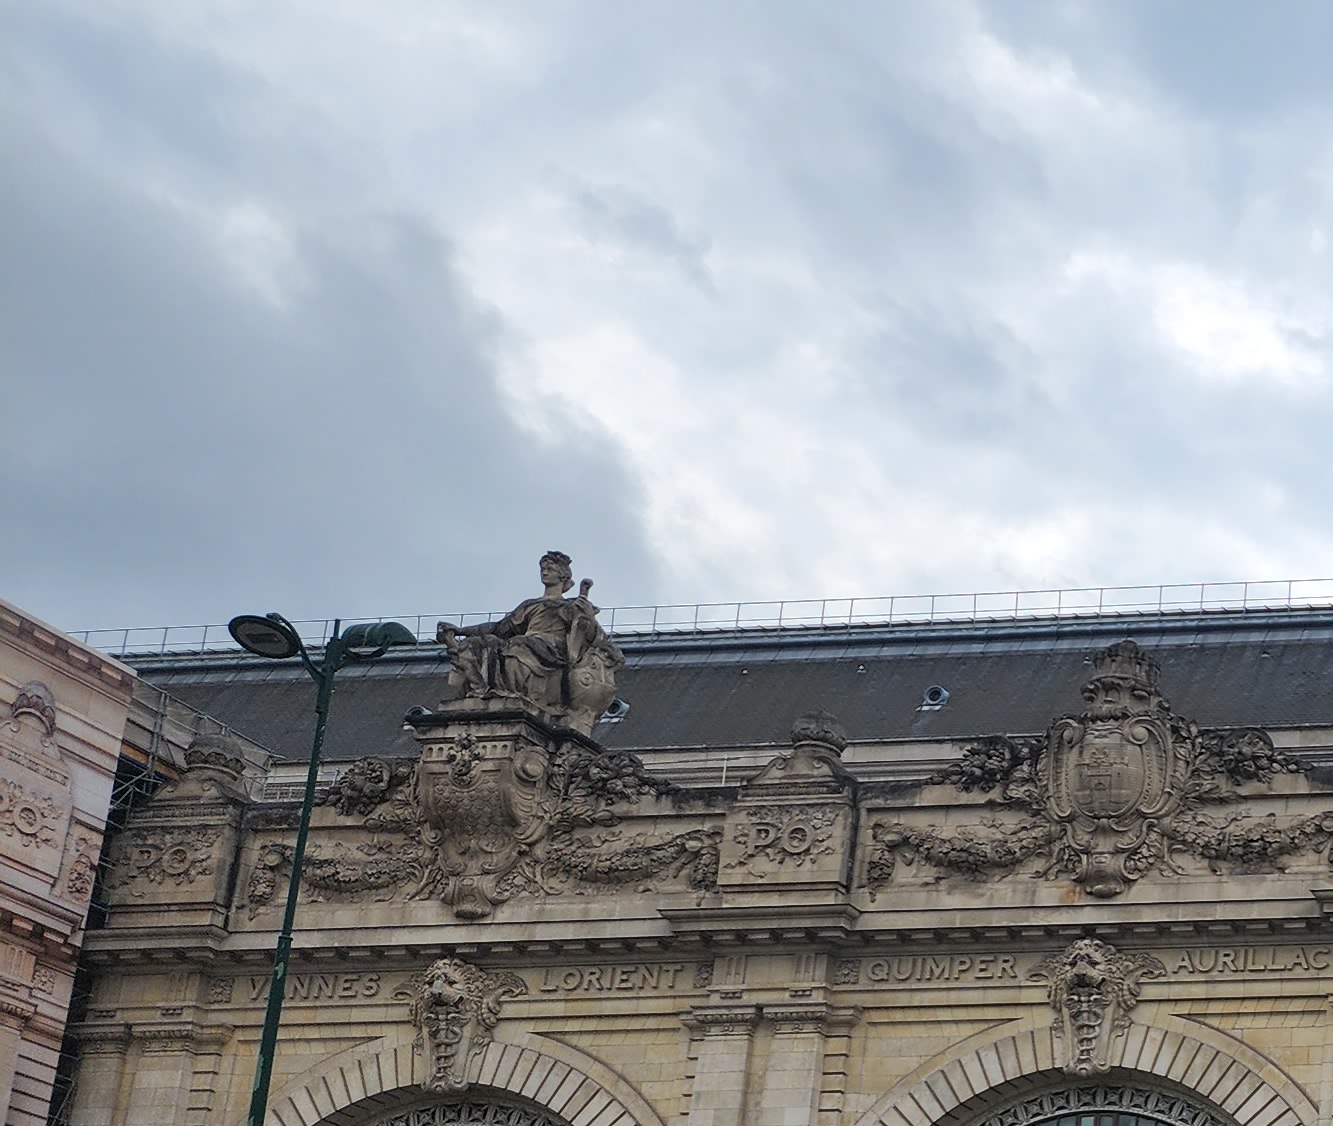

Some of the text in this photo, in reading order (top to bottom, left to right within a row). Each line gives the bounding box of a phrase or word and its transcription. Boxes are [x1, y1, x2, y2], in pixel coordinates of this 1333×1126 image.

[750, 820, 815, 857] PO
[249, 964, 685, 999] VNNES LORIENT
[865, 946, 1331, 982] QUIMPER AURILLAC
